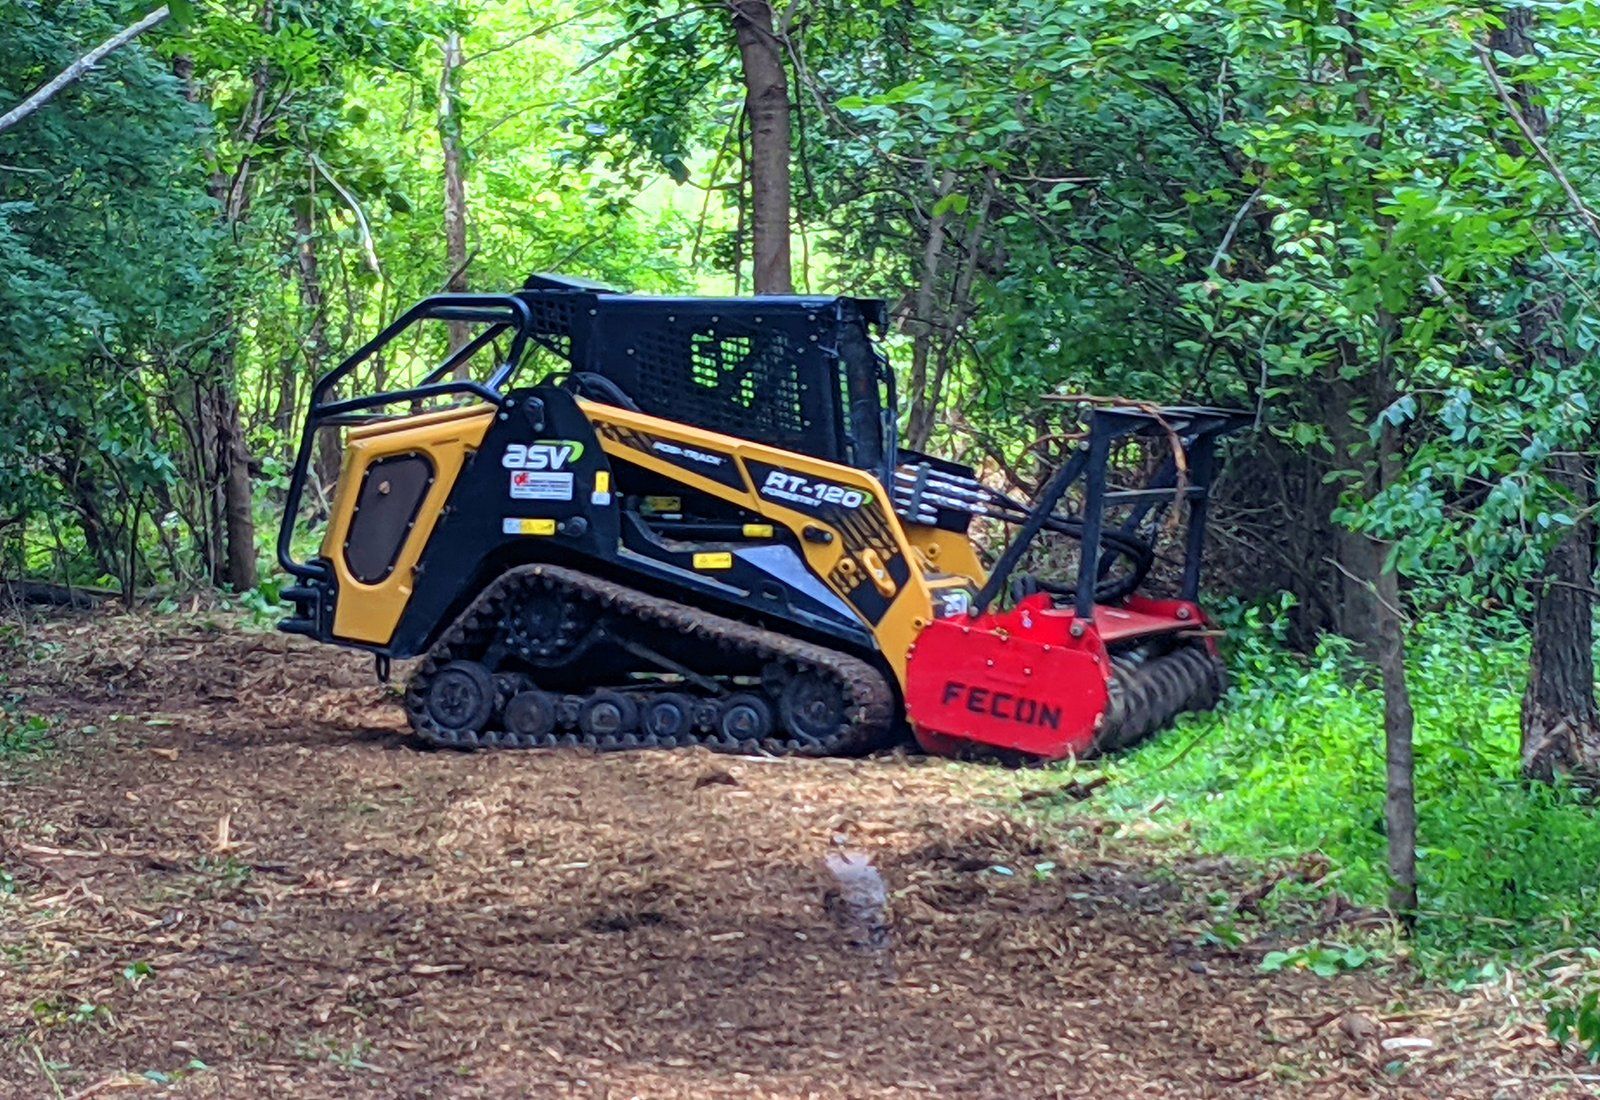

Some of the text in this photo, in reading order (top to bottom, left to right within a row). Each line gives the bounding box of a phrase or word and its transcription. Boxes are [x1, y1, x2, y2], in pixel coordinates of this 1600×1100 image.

[502, 444, 571, 469] asv
[765, 471, 862, 508] RT-120
[942, 681, 1063, 730] FECON
